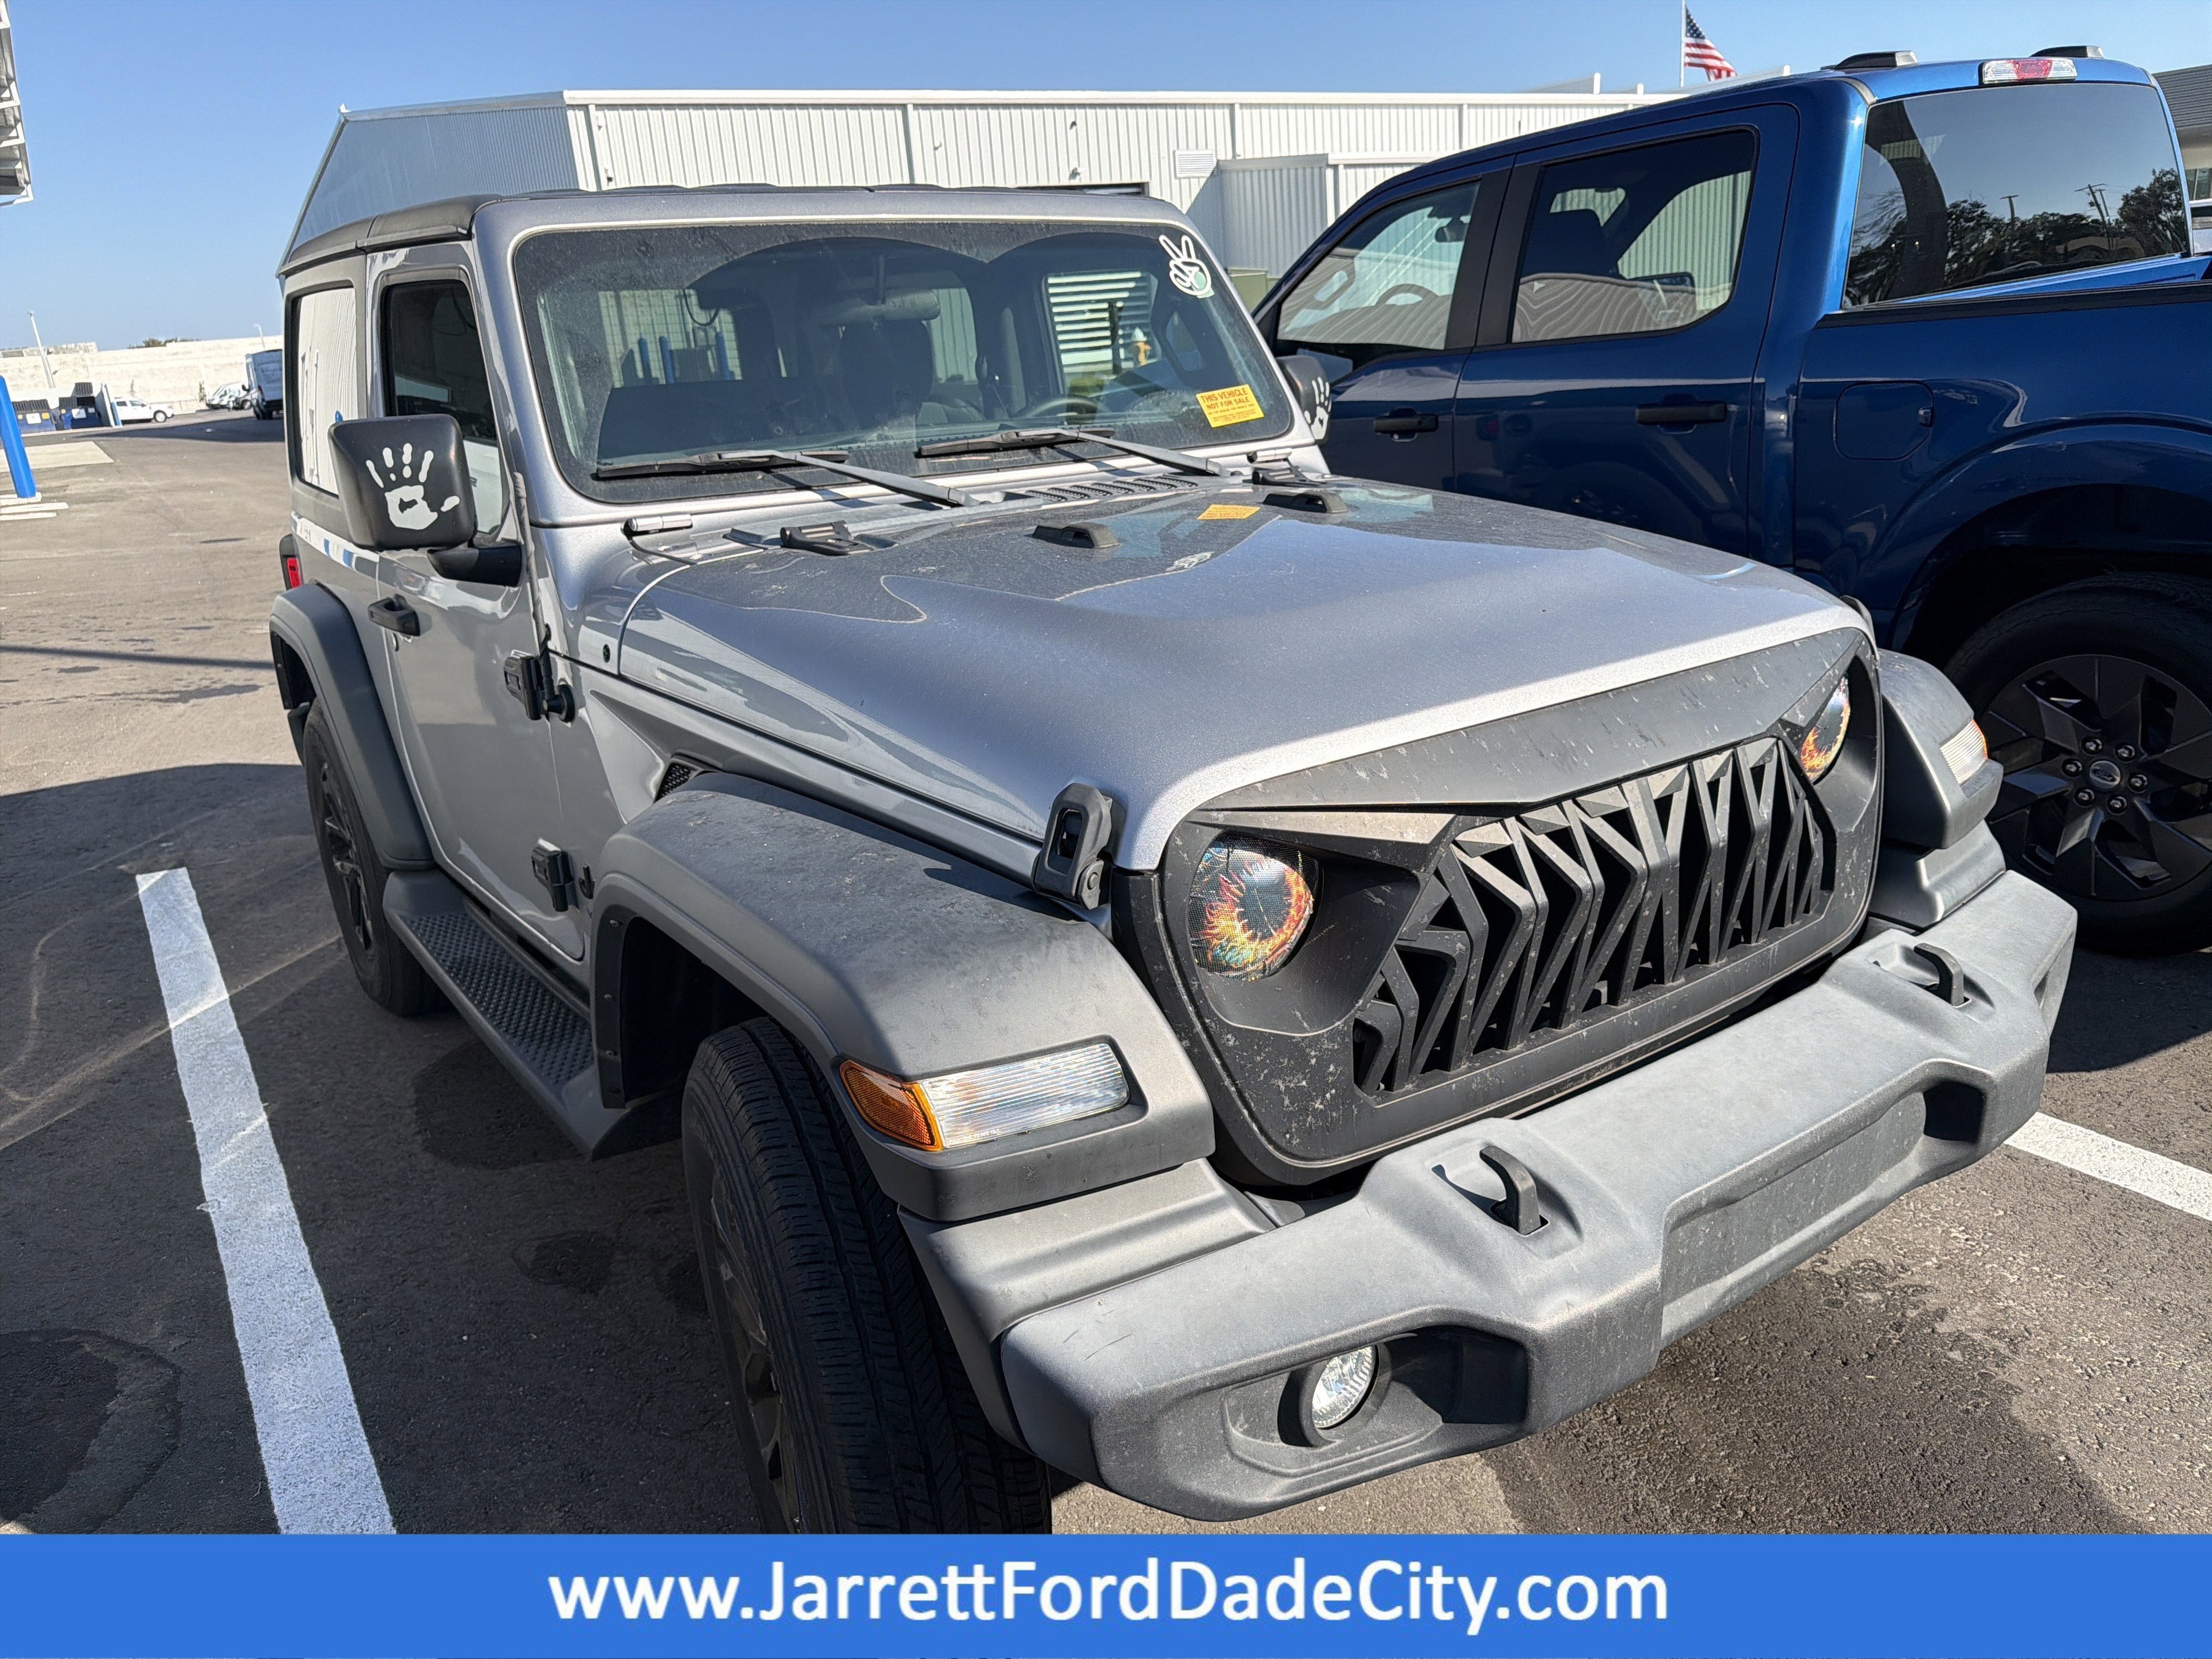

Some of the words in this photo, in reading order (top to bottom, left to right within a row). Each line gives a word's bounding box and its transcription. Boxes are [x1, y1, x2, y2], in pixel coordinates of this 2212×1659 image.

[1200, 394, 1218, 403] THIS
[1218, 388, 1248, 399] VEHICLE
[1234, 397, 1250, 405] SALE
